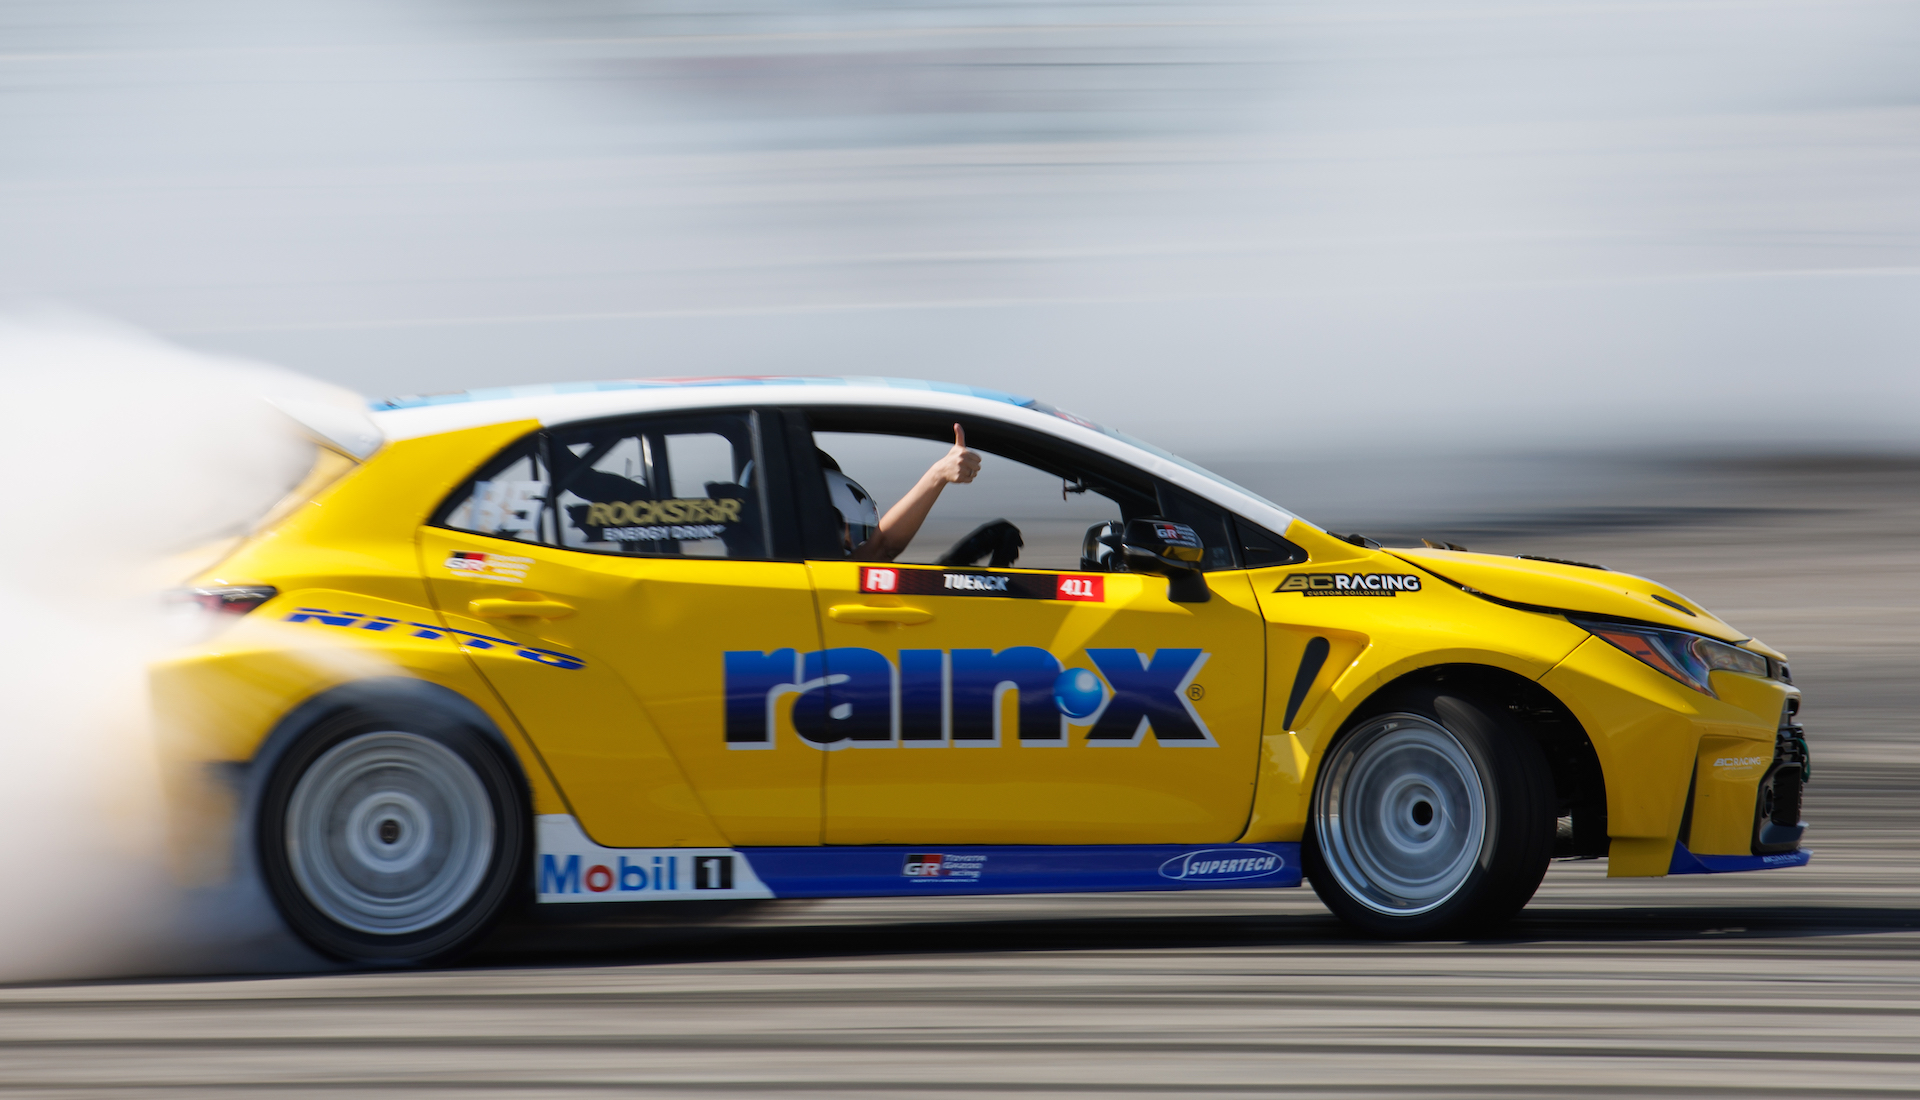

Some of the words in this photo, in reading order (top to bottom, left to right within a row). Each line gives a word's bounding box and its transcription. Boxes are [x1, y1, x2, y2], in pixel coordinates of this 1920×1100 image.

[586, 498, 741, 527] ROCKSTAR
[603, 526, 669, 541] ENERGY
[1157, 529, 1178, 539] GR
[866, 569, 896, 591] FD
[943, 573, 1010, 591] TUERCK
[1060, 579, 1094, 597] 411
[284, 607, 587, 670] NITTO
[540, 854, 678, 893] Mobil
[903, 863, 940, 876] GR
[1188, 856, 1276, 875] SUPERTECH
